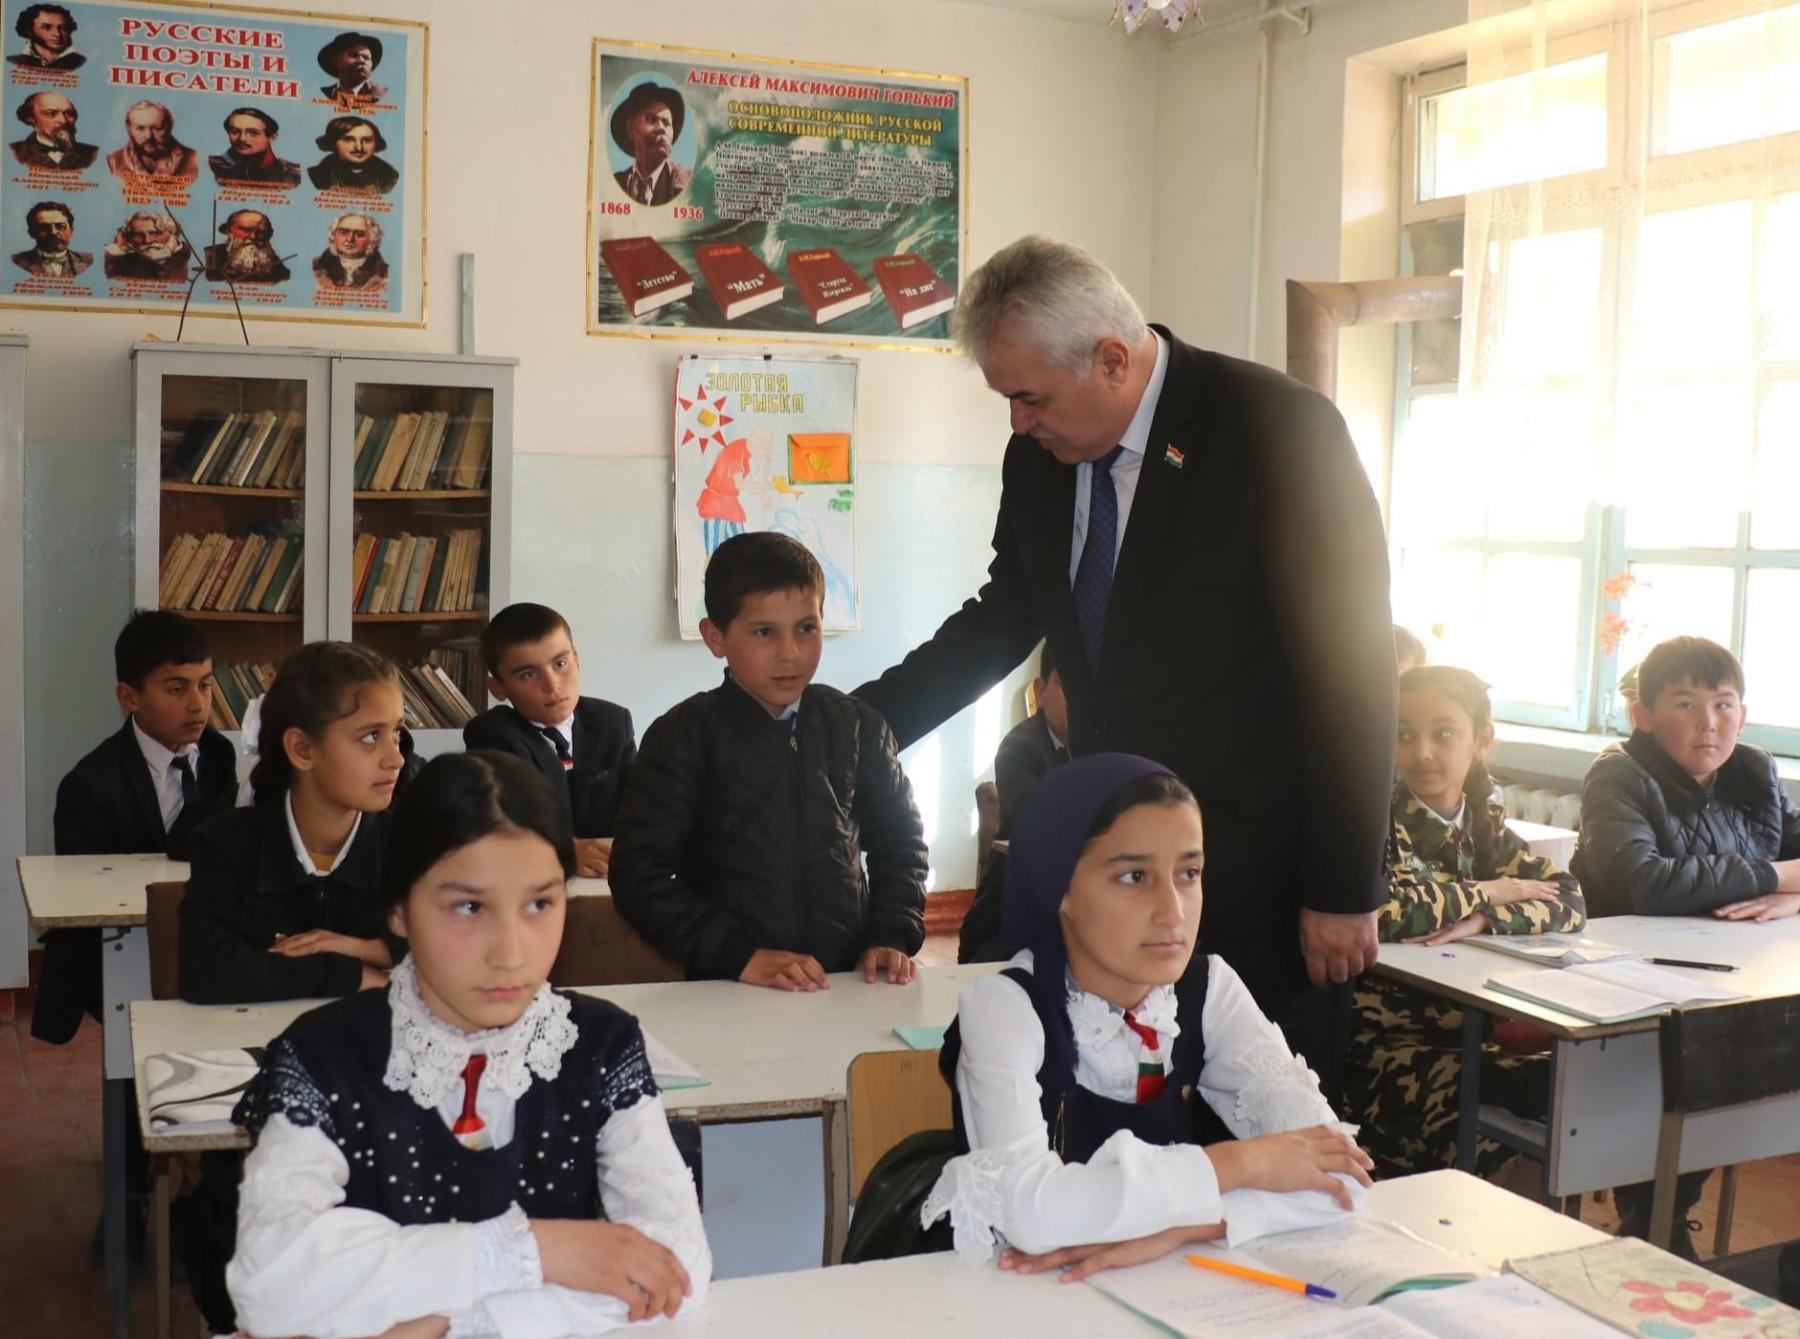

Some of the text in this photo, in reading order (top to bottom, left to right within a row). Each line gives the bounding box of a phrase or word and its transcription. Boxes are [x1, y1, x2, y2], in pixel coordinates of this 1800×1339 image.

[121, 19, 283, 48] РУССКИЕ
[125, 43, 287, 73] ПОЭТЫ И
[110, 66, 299, 98] ПИСАТЕЛИ
[689, 70, 956, 109] АЛЕКСЕЙ МАКСИМОВИЧ ГОРЬКИЙ
[728, 100, 944, 133] ОСНОВОПОЛОЖНИК РУССКОЙ
[728, 116, 933, 147] СОВРЕМЕННОЙ ЛИТЕРАТУРЫ
[600, 202, 632, 216] 1868
[673, 206, 704, 220] 1936
[705, 371, 789, 393] ЗОЛОТАЯ
[740, 392, 804, 414] РЫБКА
